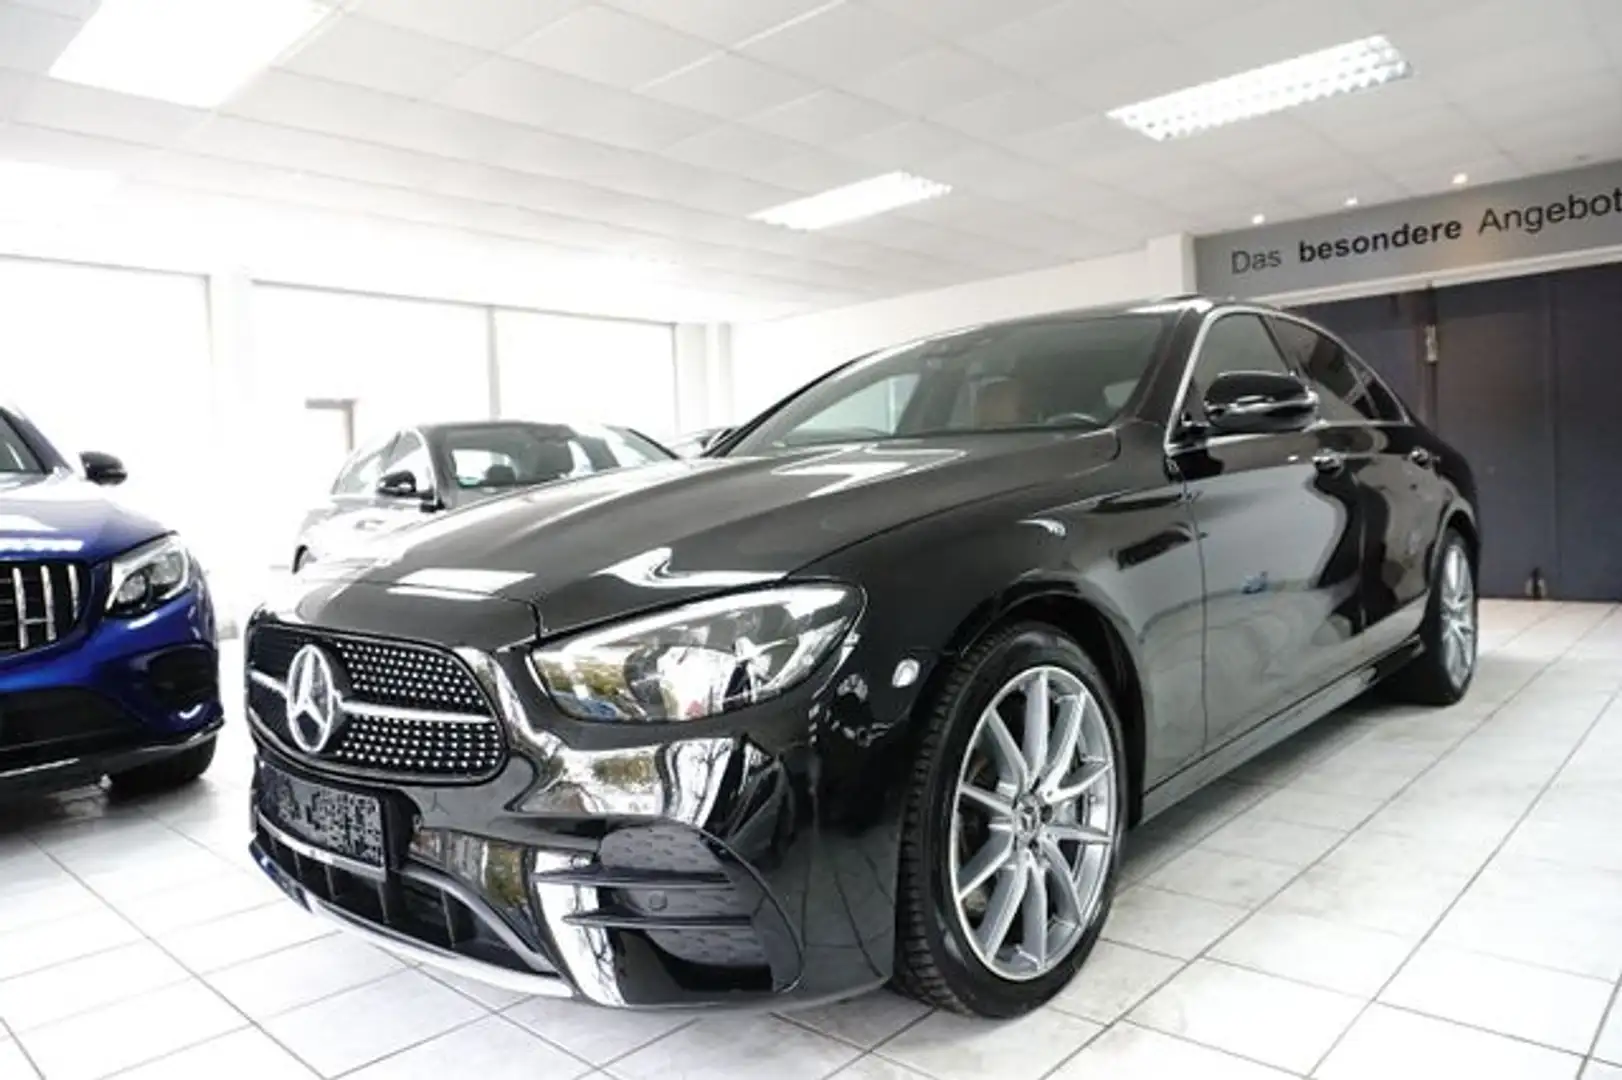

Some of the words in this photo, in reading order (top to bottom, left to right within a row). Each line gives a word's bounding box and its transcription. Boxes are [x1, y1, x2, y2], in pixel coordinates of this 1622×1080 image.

[1231, 249, 1282, 275] Das
[1299, 220, 1462, 263] besondere
[1478, 187, 1622, 235] Angebot
